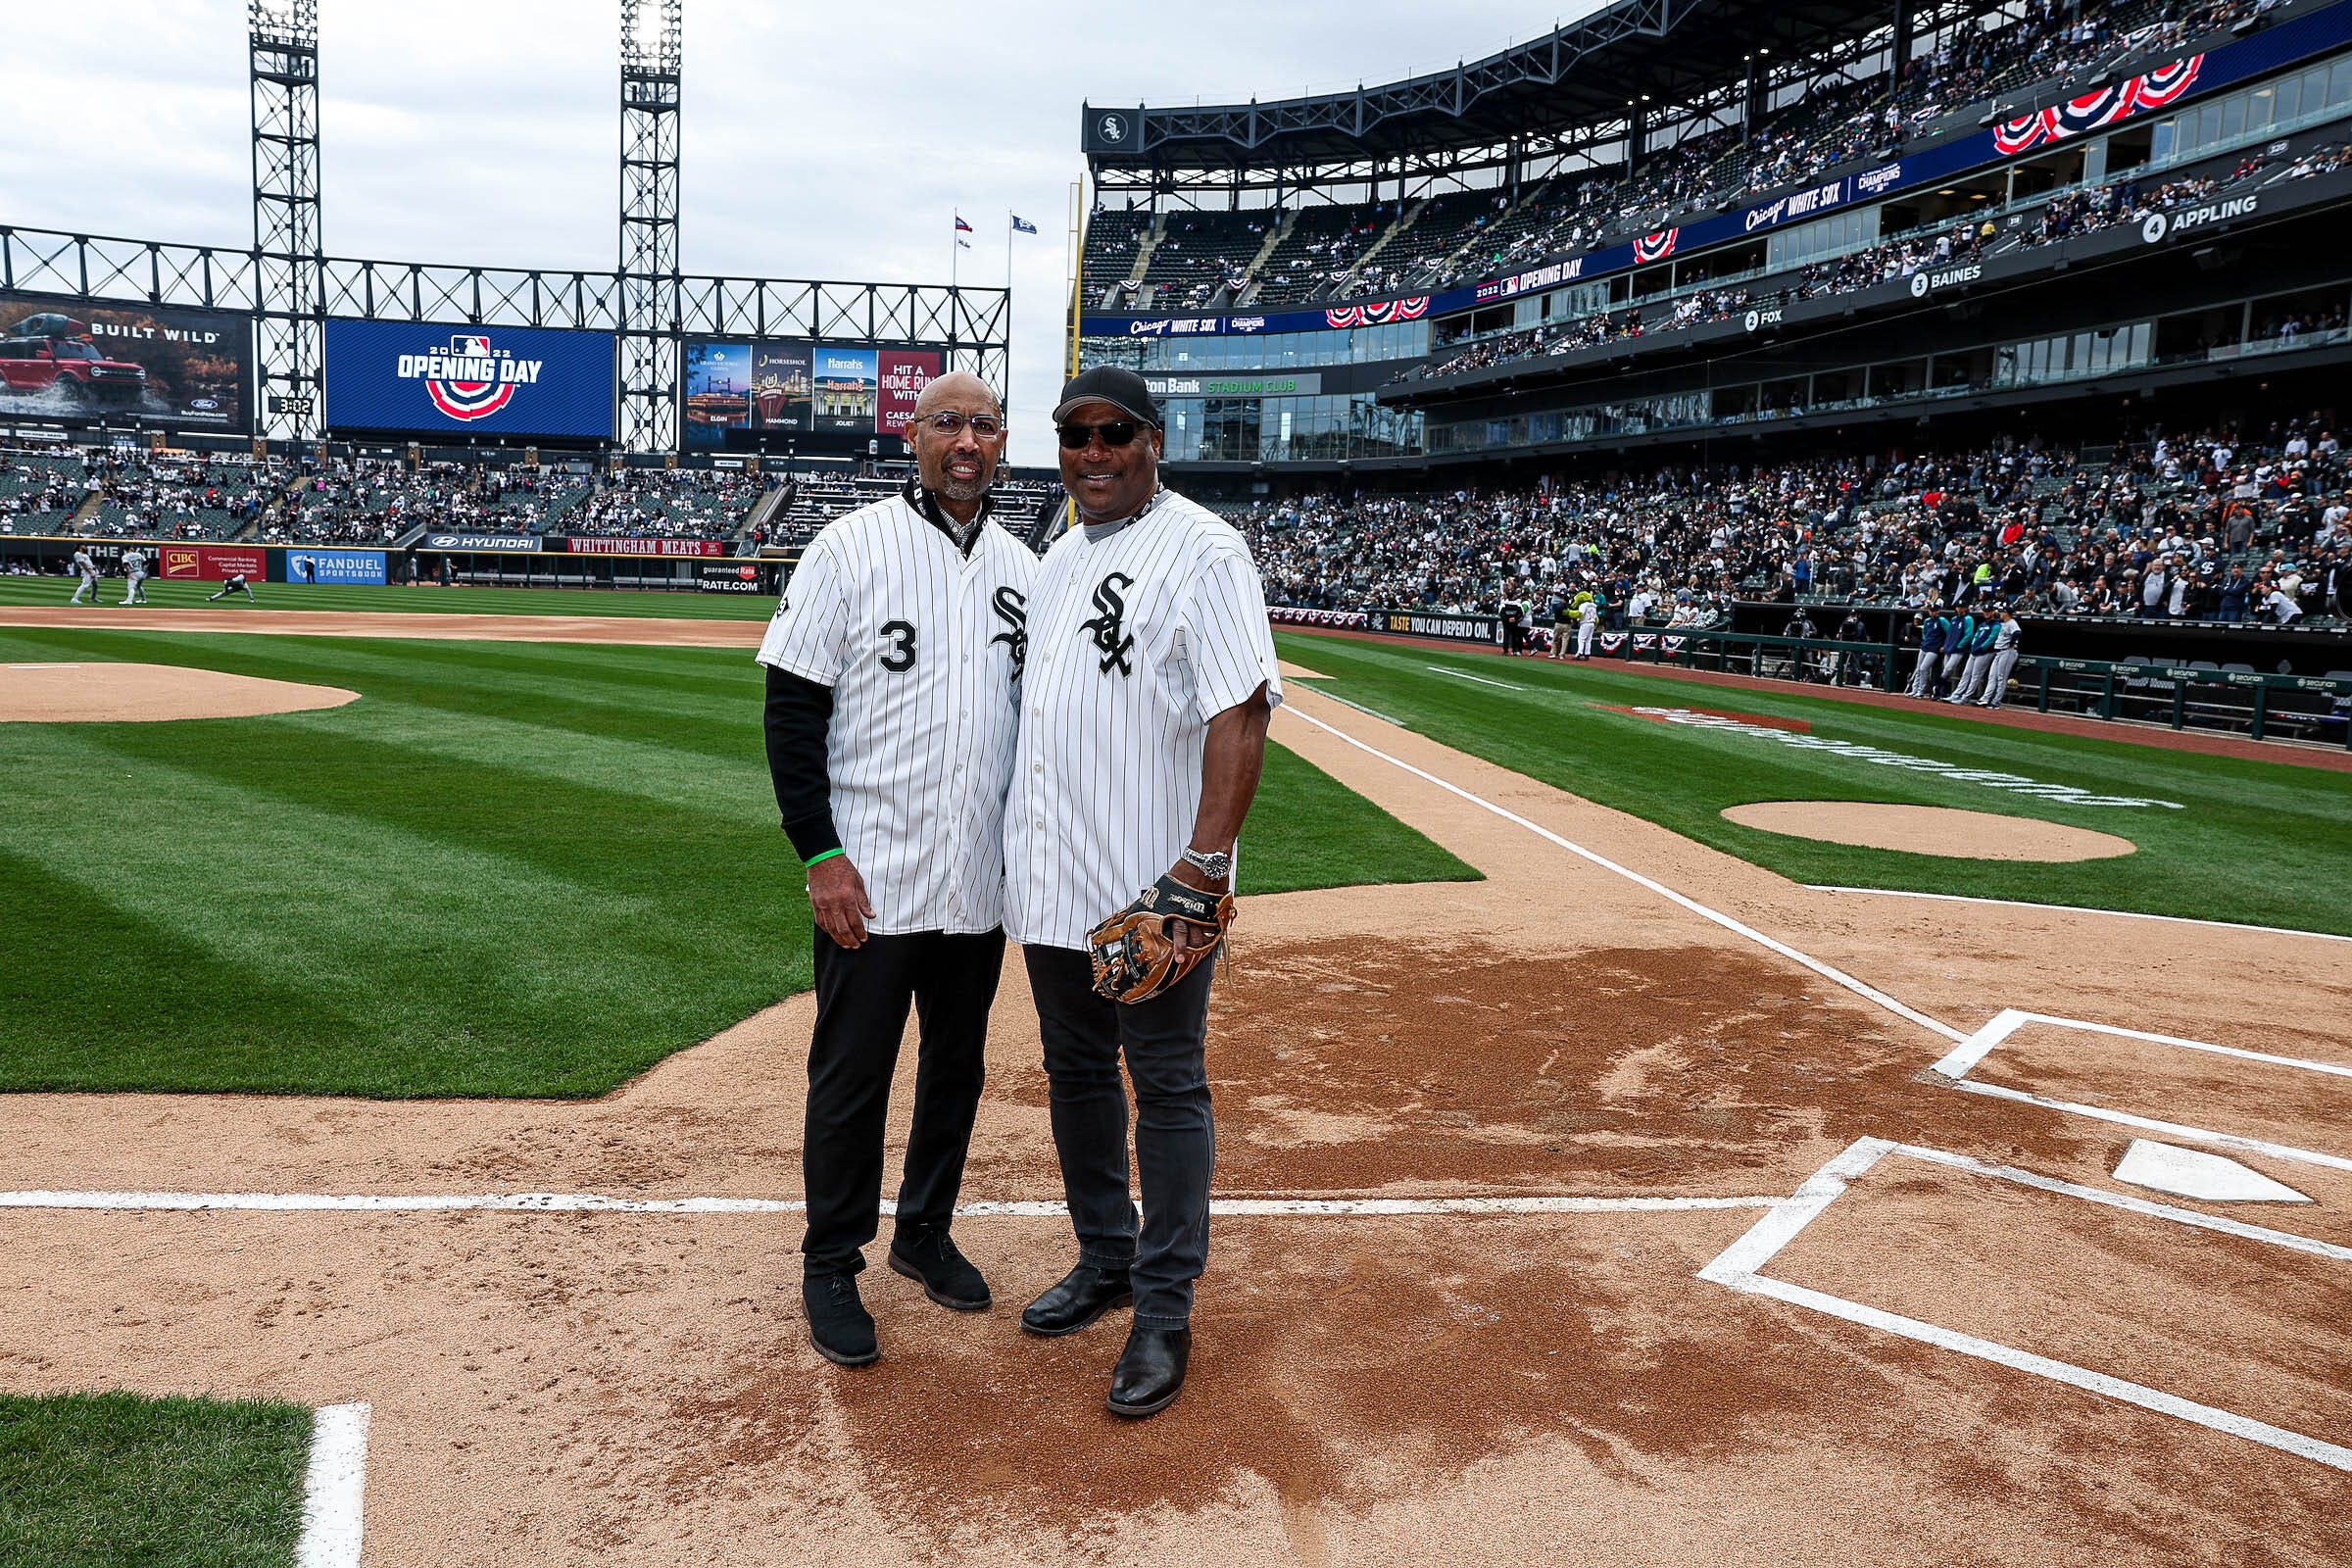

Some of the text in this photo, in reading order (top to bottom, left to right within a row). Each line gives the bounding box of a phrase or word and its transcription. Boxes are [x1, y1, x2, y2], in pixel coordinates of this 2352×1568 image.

[1858, 166, 1901, 189] CHAMPIONS
[1745, 181, 1841, 231] Chicago WHITE SOX
[2171, 196, 2258, 231] APPLING
[1476, 258, 1583, 297] 2022 OPENING DAY
[1931, 266, 1982, 288] BAINES
[1760, 310, 1783, 324] FOX
[91, 323, 216, 344] BUILT WILD
[1130, 318, 1216, 334] Chicago WHITE SOX
[429, 346, 511, 358] 20 22
[397, 355, 543, 383] OPENING DAY
[893, 365, 924, 375] HIT A
[882, 374, 910, 390] HOME
[1167, 378, 1200, 393] Bank
[1207, 381, 1262, 393] STADIUM
[1265, 379, 1296, 392] CLUB
[281, 398, 311, 414] 3:02
[462, 537, 534, 549] HYUNDAI
[571, 539, 657, 555] WHITTINGHAM
[662, 541, 702, 556] MEATS
[86, 546, 119, 558] THE
[169, 553, 196, 564] CIBC
[318, 558, 382, 570] FANDUEL
[318, 569, 382, 578] SPORTSBOOK
[702, 580, 758, 592] RATE.COM
[1390, 615, 1491, 639] TASTE YOU CAN DEPEND ON.
[880, 618, 918, 675] 3
